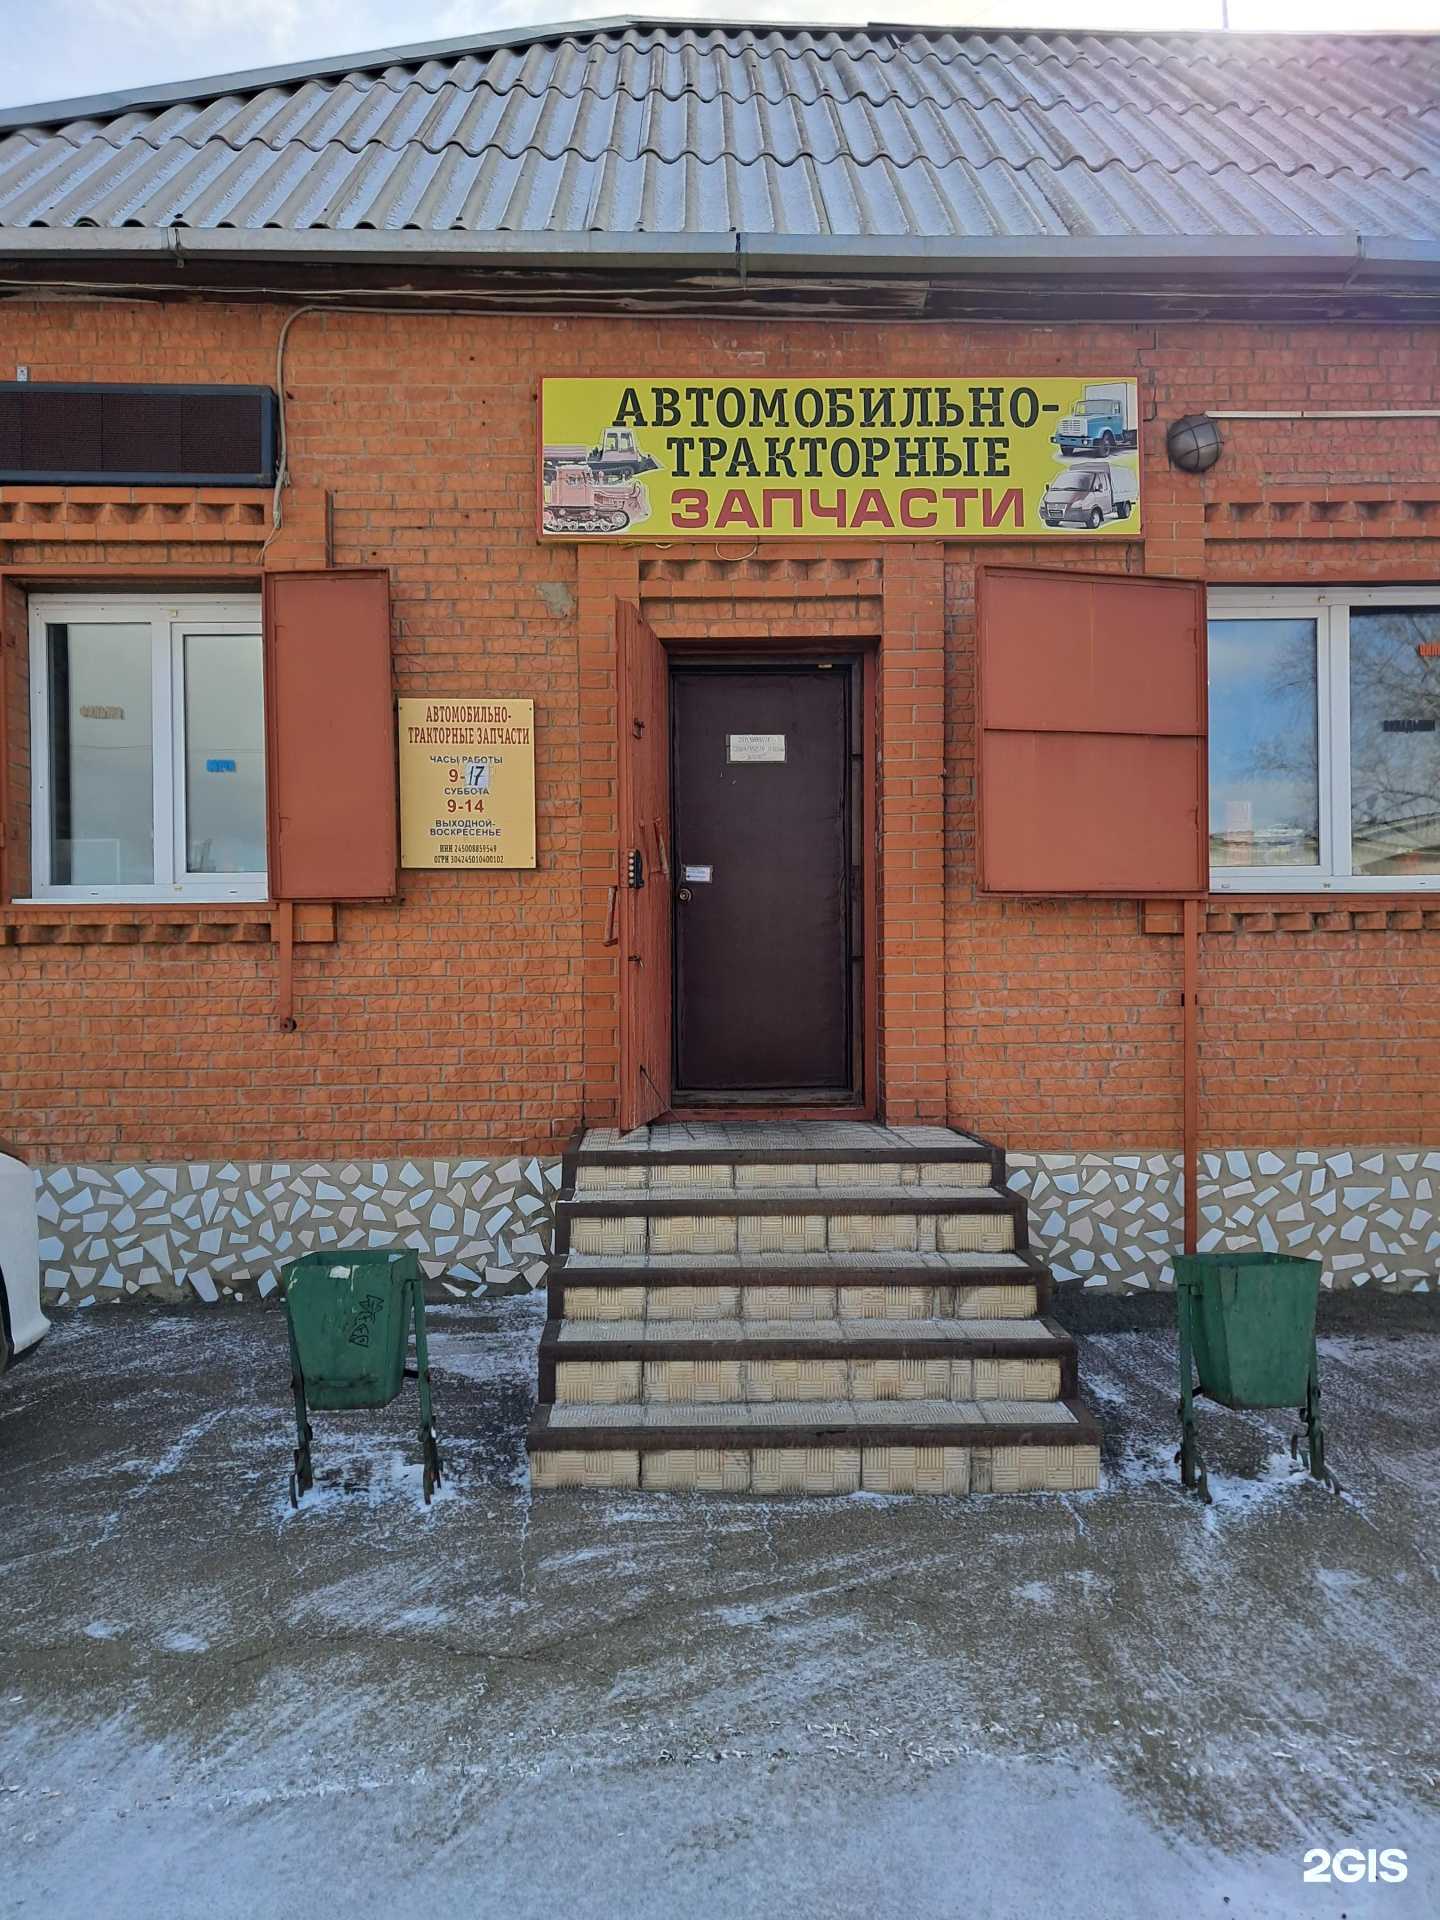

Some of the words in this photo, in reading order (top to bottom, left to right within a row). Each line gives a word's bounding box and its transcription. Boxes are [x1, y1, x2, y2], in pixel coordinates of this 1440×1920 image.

[612, 387, 1060, 428] АВТОМОБИЛЬНО-
[666, 436, 1010, 478] ТРАКТОРНЫЕ
[670, 488, 1024, 528] ЗАПЧАСТИ
[426, 706, 512, 723] АВТОМОБИЛЬНО-
[408, 727, 475, 744] ТРАКТОРНЫЕ
[477, 728, 529, 745] ЗАПЧАСТИ
[430, 756, 459, 764] ЧАСЫ
[462, 756, 503, 764] РАБОТЫ
[447, 799, 484, 813] 9-14
[430, 828, 502, 837] ВОСКРЕСЕНЬЕ
